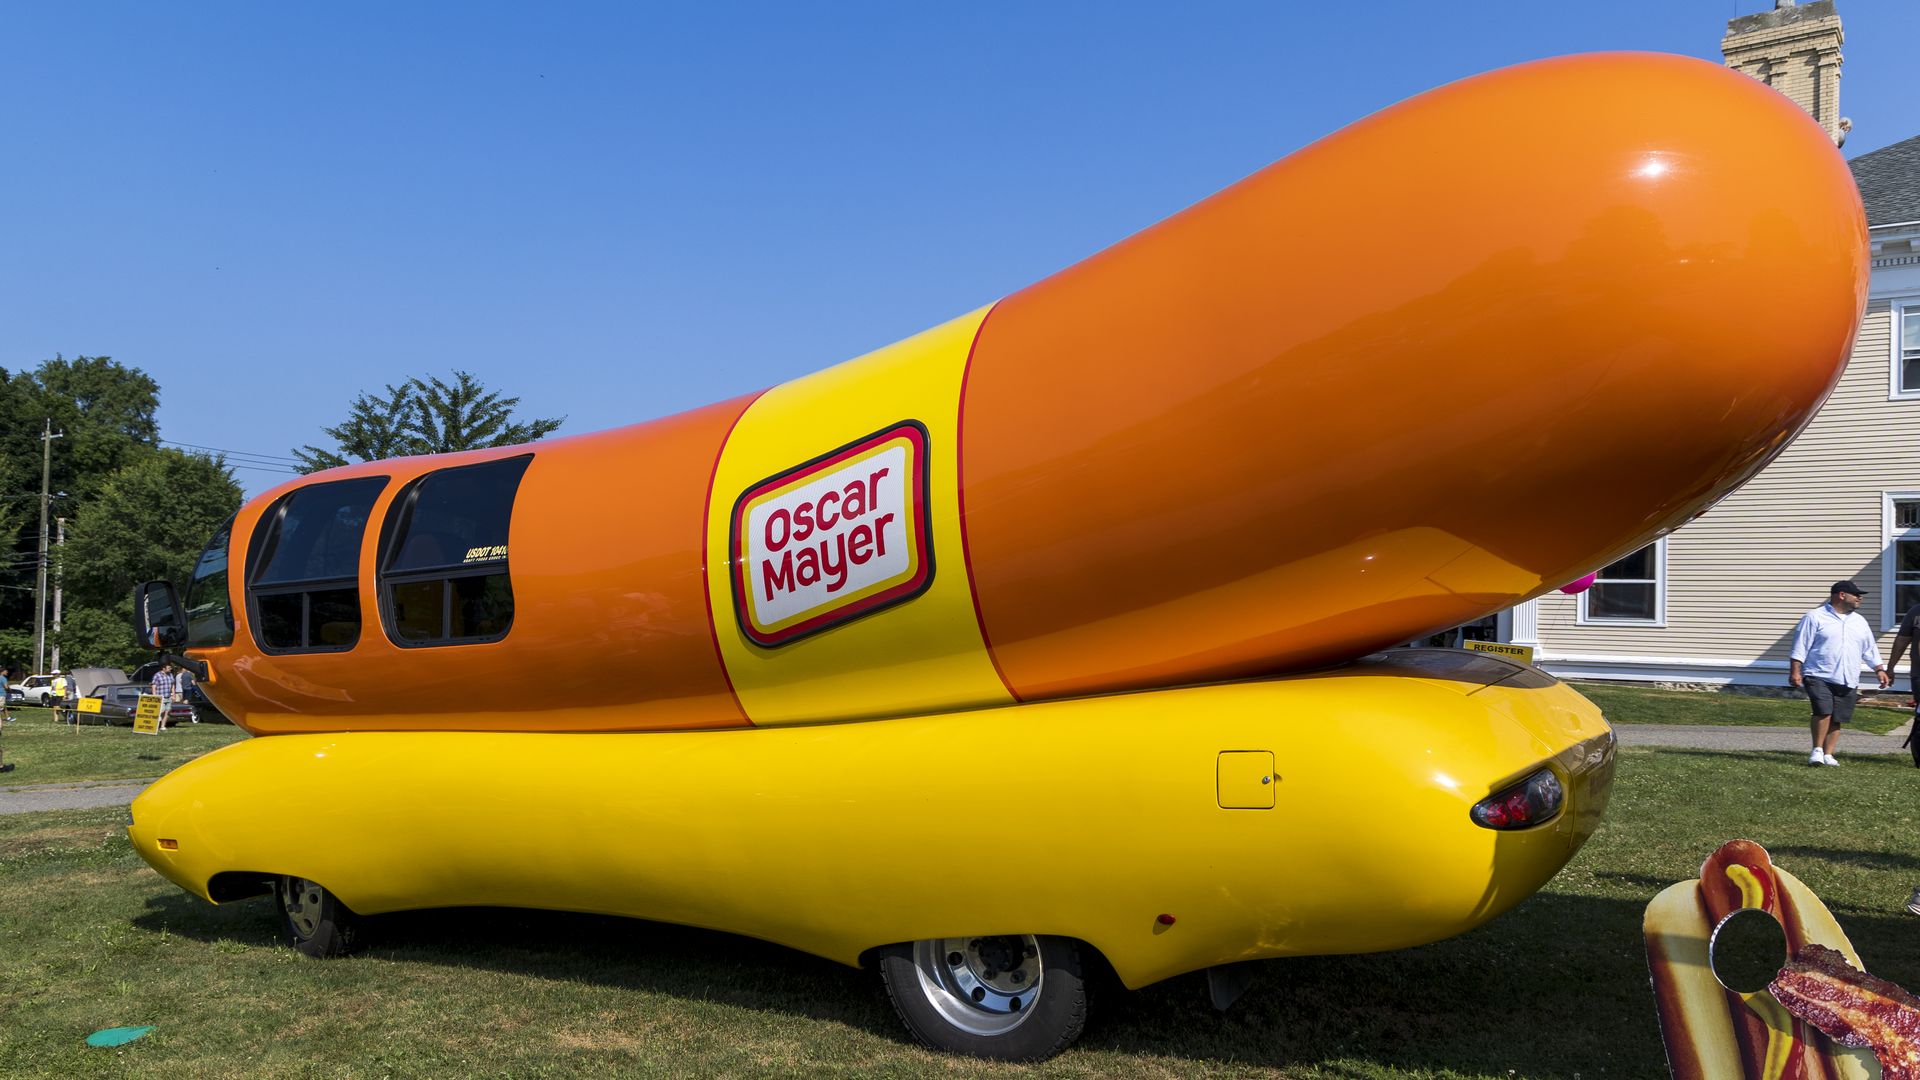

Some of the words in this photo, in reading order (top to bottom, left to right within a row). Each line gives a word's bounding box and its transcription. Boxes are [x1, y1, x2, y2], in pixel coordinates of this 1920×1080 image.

[764, 467, 889, 552] Oscar
[466, 546, 491, 558] USDOT
[762, 513, 894, 602] Mayer
[1473, 644, 1524, 655] REGISTER
